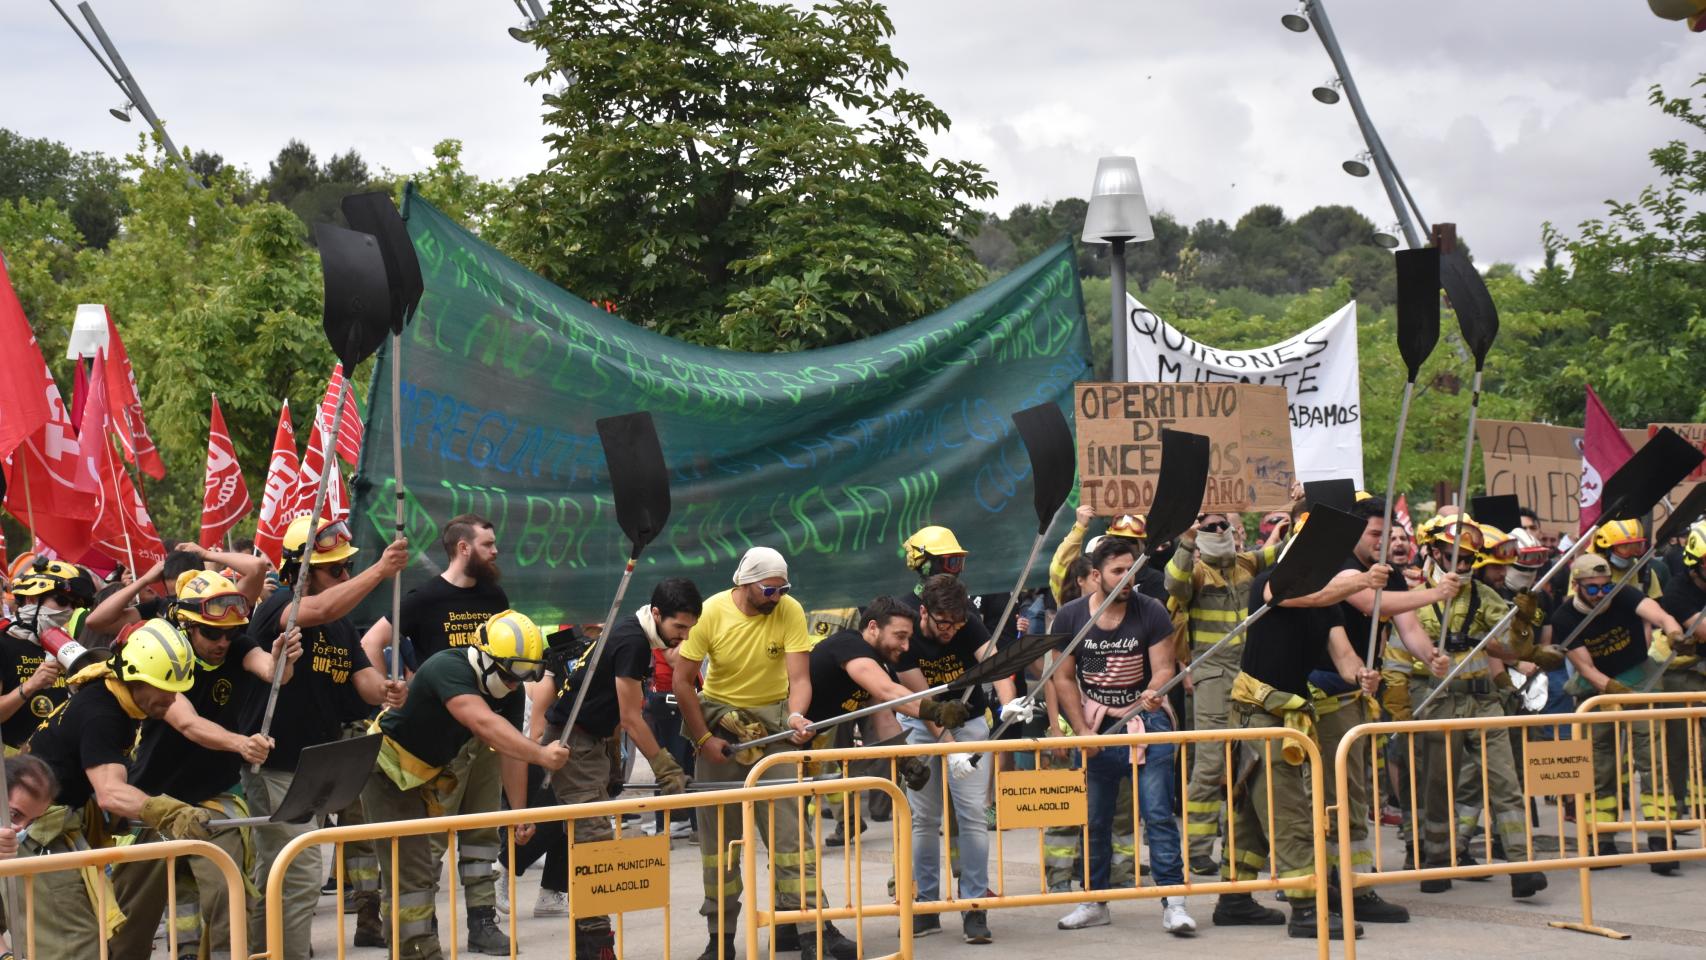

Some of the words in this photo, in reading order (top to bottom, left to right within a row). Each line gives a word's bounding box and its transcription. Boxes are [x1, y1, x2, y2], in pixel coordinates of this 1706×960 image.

[1158, 354, 1320, 395] MITE
[1491, 425, 1530, 464] LA
[1083, 479, 1154, 511] TODO
[1491, 470, 1580, 523] CULEB
[444, 621, 477, 632] Forest
[1084, 639, 1098, 650] The
[1100, 639, 1121, 650] Good
[1122, 637, 1139, 651] Life
[21, 655, 46, 665] Bomb
[1086, 689, 1142, 705] AMERICA
[1002, 787, 1037, 796] POLICIA
[1040, 785, 1085, 795] MUNICIPAL
[1016, 801, 1070, 812] VALLADOLID
[575, 863, 614, 877] POLICIA
[617, 857, 666, 872] MUNICIPAL
[591, 879, 650, 895] VALLADOLID
